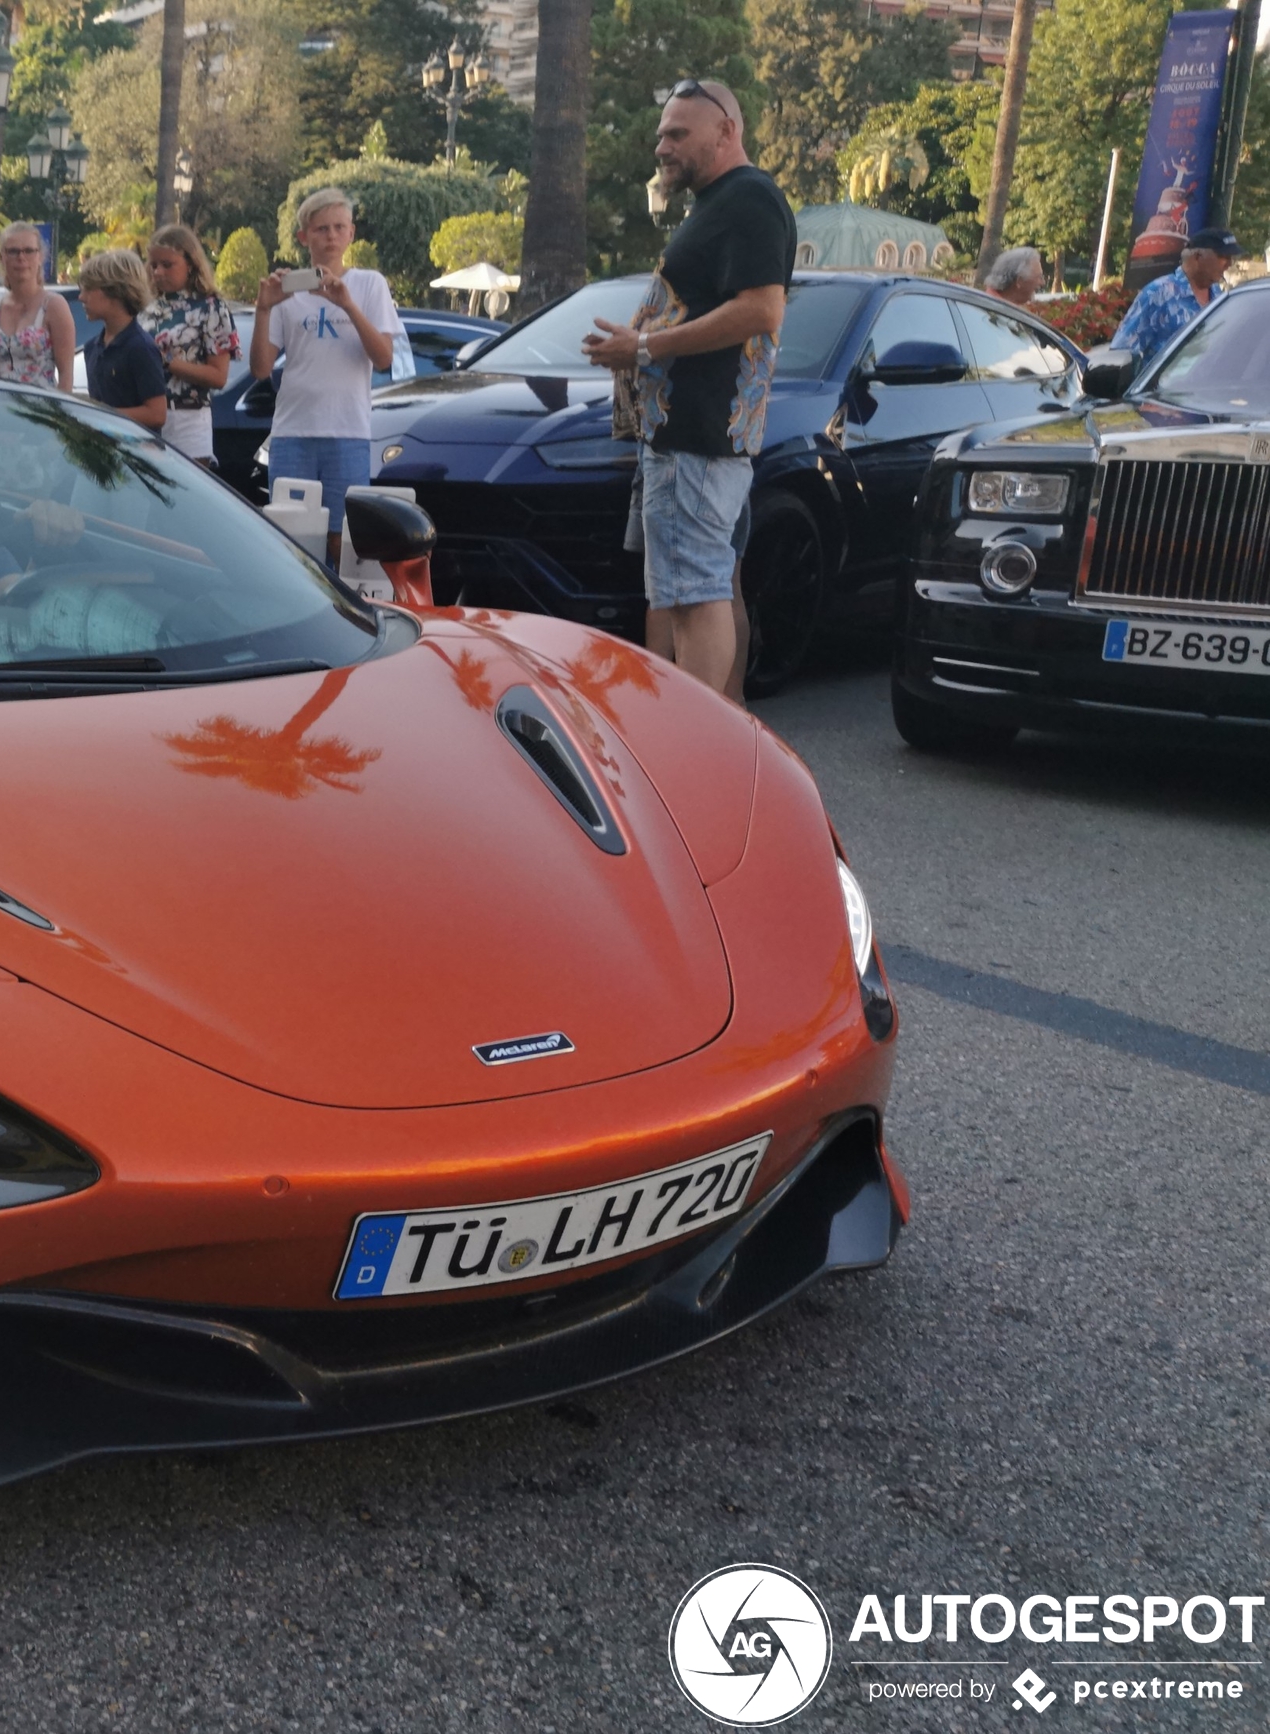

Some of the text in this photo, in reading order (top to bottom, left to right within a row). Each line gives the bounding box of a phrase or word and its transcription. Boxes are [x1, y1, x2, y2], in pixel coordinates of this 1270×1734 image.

[1160, 80, 1219, 94] CIRQUE DU SOLEIL
[489, 1037, 560, 1059] McLaren
[408, 1150, 759, 1284] TÜ LH 720
[356, 1265, 376, 1284] D
